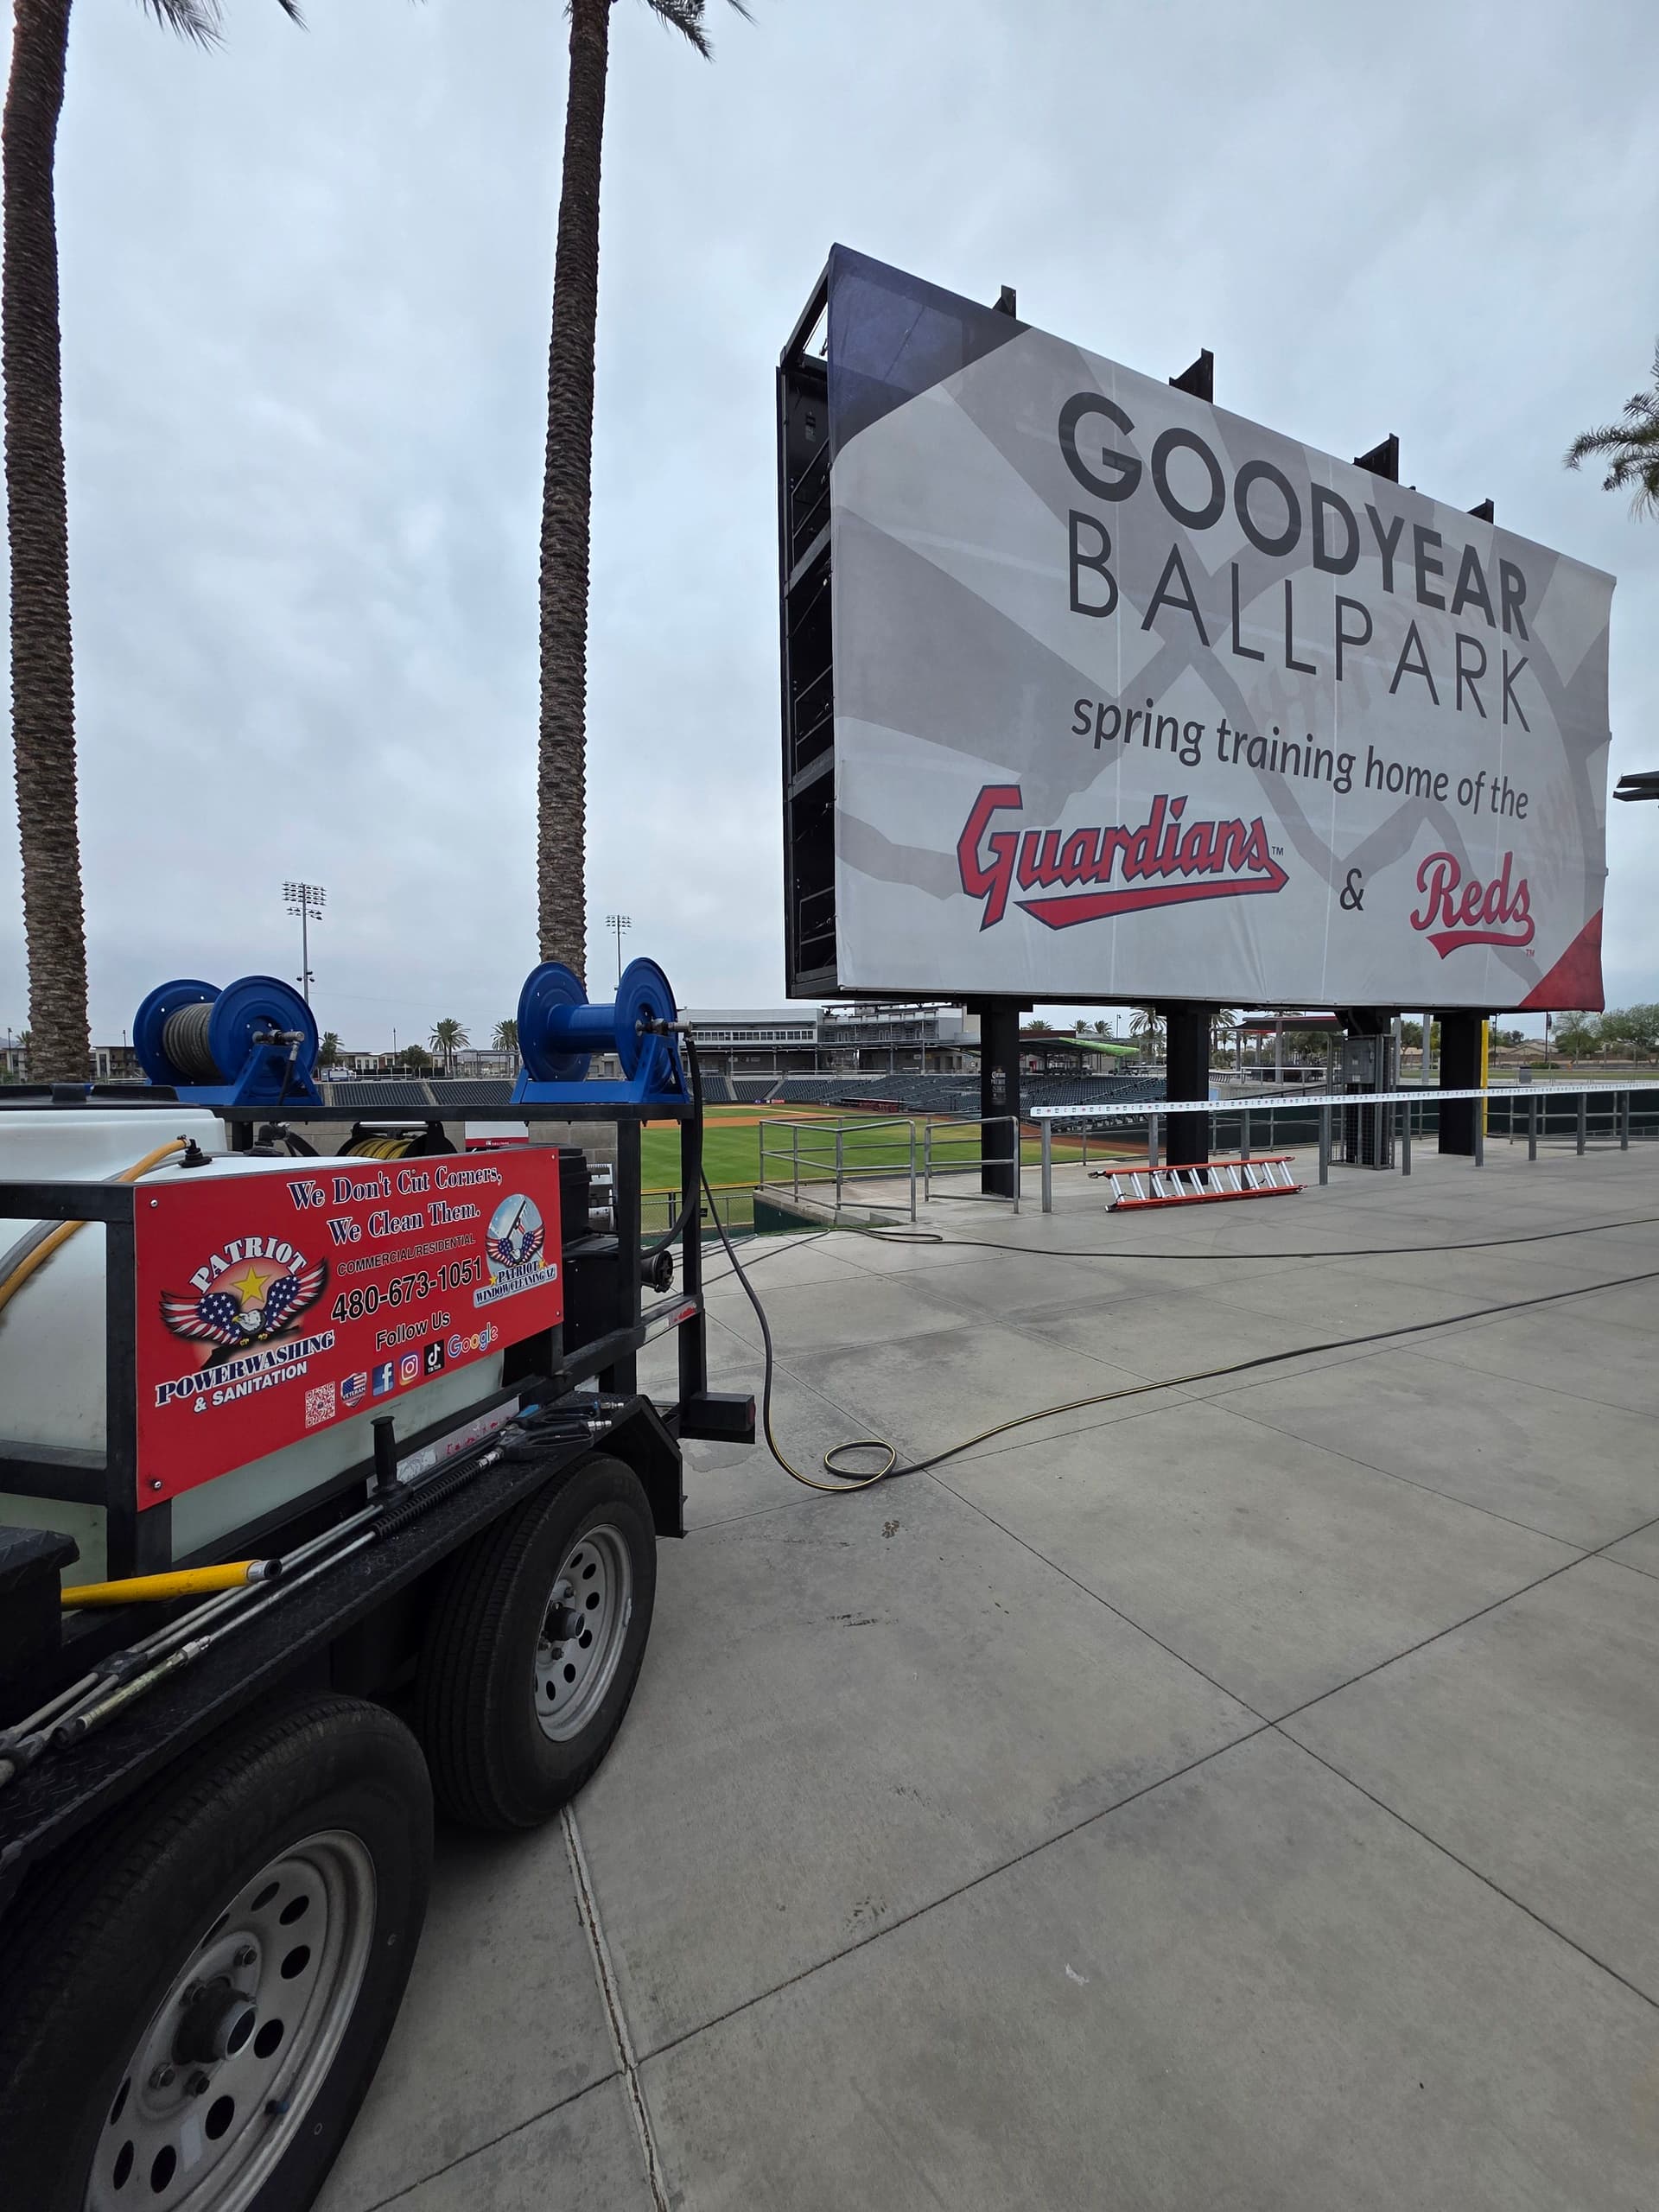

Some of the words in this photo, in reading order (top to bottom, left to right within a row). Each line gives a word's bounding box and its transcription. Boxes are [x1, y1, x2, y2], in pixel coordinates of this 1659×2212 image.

[1058, 391, 1530, 642] GOODYEAR
[1068, 508, 1531, 733] BALLPARK
[1071, 697, 1205, 767] spring
[1216, 718, 1357, 794] training
[1364, 745, 1449, 802] home
[1457, 771, 1487, 815] of
[1491, 776, 1529, 820] the
[957, 784, 1289, 932] Guardians
[1339, 868, 1364, 912] &
[1409, 850, 1535, 933] Reds
[287, 1180, 325, 1210] We
[333, 1170, 391, 1205] Don't
[397, 1168, 430, 1195] Cut
[435, 1166, 503, 1190] Corners,
[327, 1217, 361, 1246] We
[368, 1210, 423, 1238] Clean
[428, 1201, 481, 1226] Them.
[188, 1236, 308, 1294] PATRIOT
[337, 1233, 476, 1276] COMMERCIAL/RESIDENTIAL
[498, 1260, 539, 1283] PATRIOT
[331, 1255, 482, 1323] 480-673-1051
[475, 1284, 511, 1303] WINDOW
[510, 1271, 545, 1290] CLEANING
[546, 1267, 555, 1281] AZ
[375, 1319, 429, 1351] Follow
[431, 1311, 451, 1331] Us
[447, 1322, 499, 1358] Google
[155, 1329, 336, 1408] POWERWASHING
[193, 1396, 207, 1414] &
[212, 1361, 308, 1407] SANITATION
[342, 1385, 366, 1400] VETERAN
